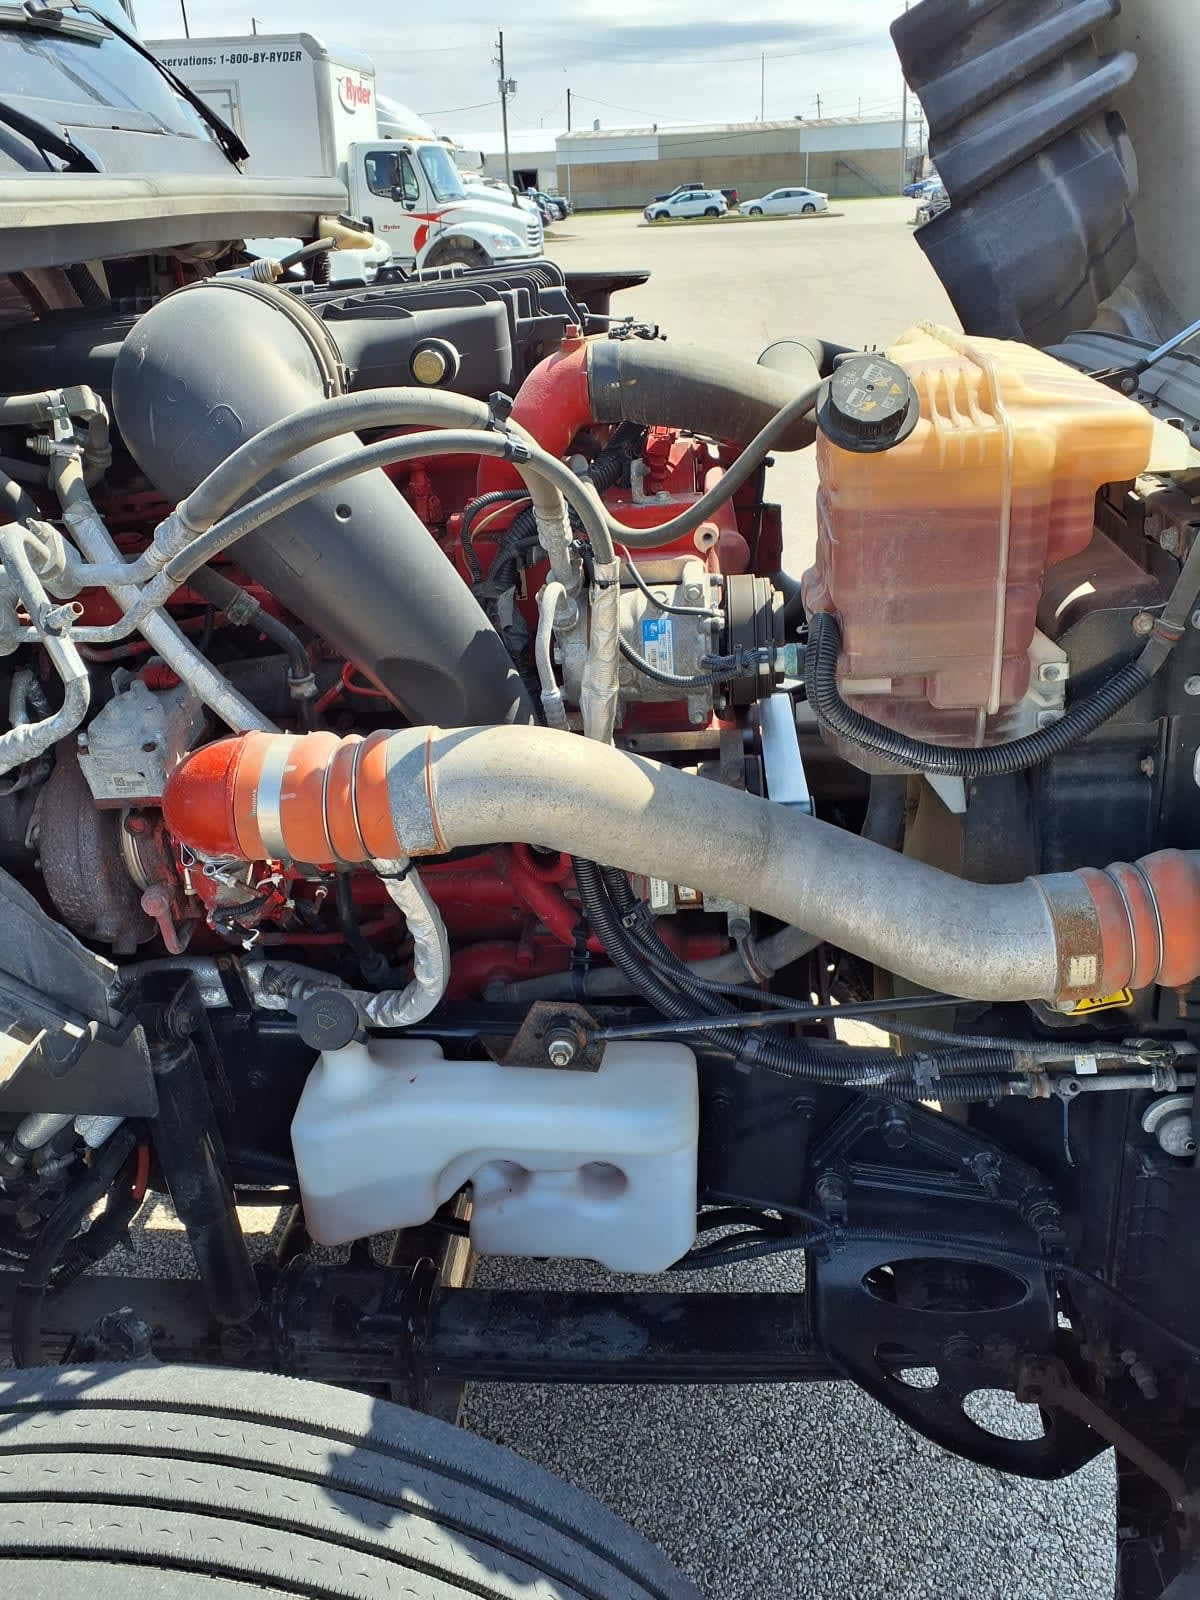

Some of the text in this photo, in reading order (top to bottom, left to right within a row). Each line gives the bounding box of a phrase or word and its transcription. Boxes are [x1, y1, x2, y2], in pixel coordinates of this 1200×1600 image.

[160, 50, 302, 67] servations: 1-800-BY-RYDER
[345, 76, 371, 107] Ryder
